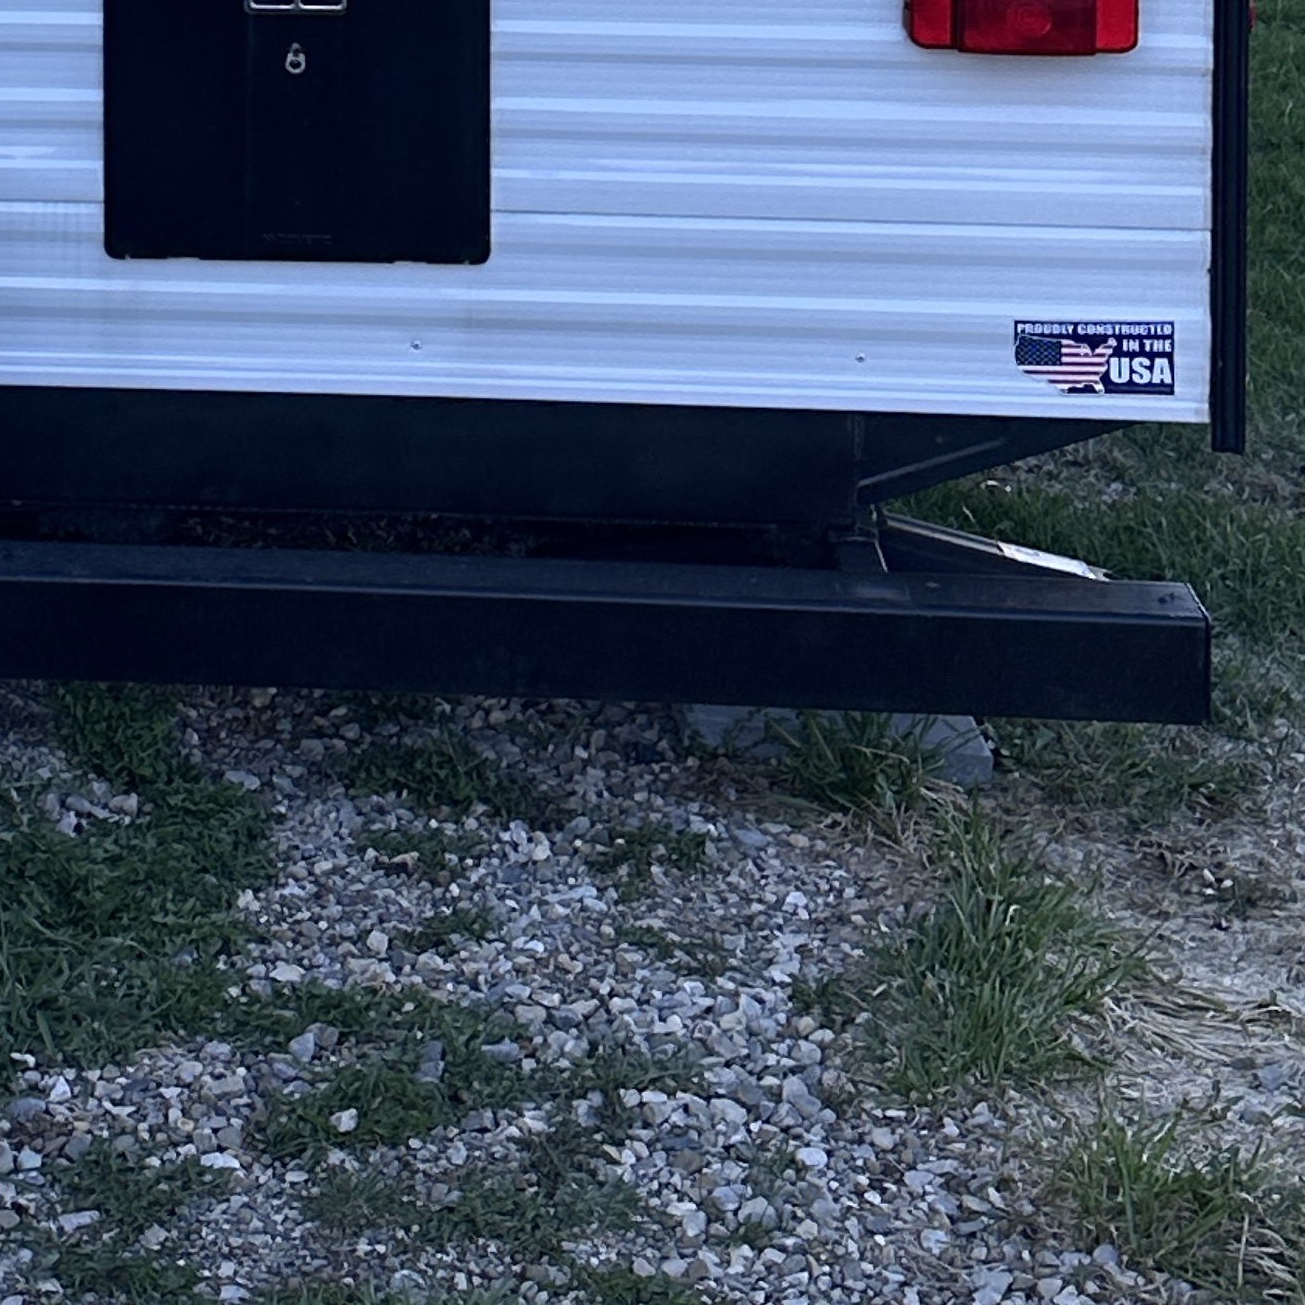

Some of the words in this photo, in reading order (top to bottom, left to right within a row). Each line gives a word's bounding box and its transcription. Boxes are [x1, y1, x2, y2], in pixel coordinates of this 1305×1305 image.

[1017, 323, 1074, 335] PROUDLY
[1077, 324, 1172, 336] CONSTRUCTED
[1122, 339, 1140, 352] IN
[1143, 339, 1172, 352] THE
[1109, 356, 1173, 384] USA
